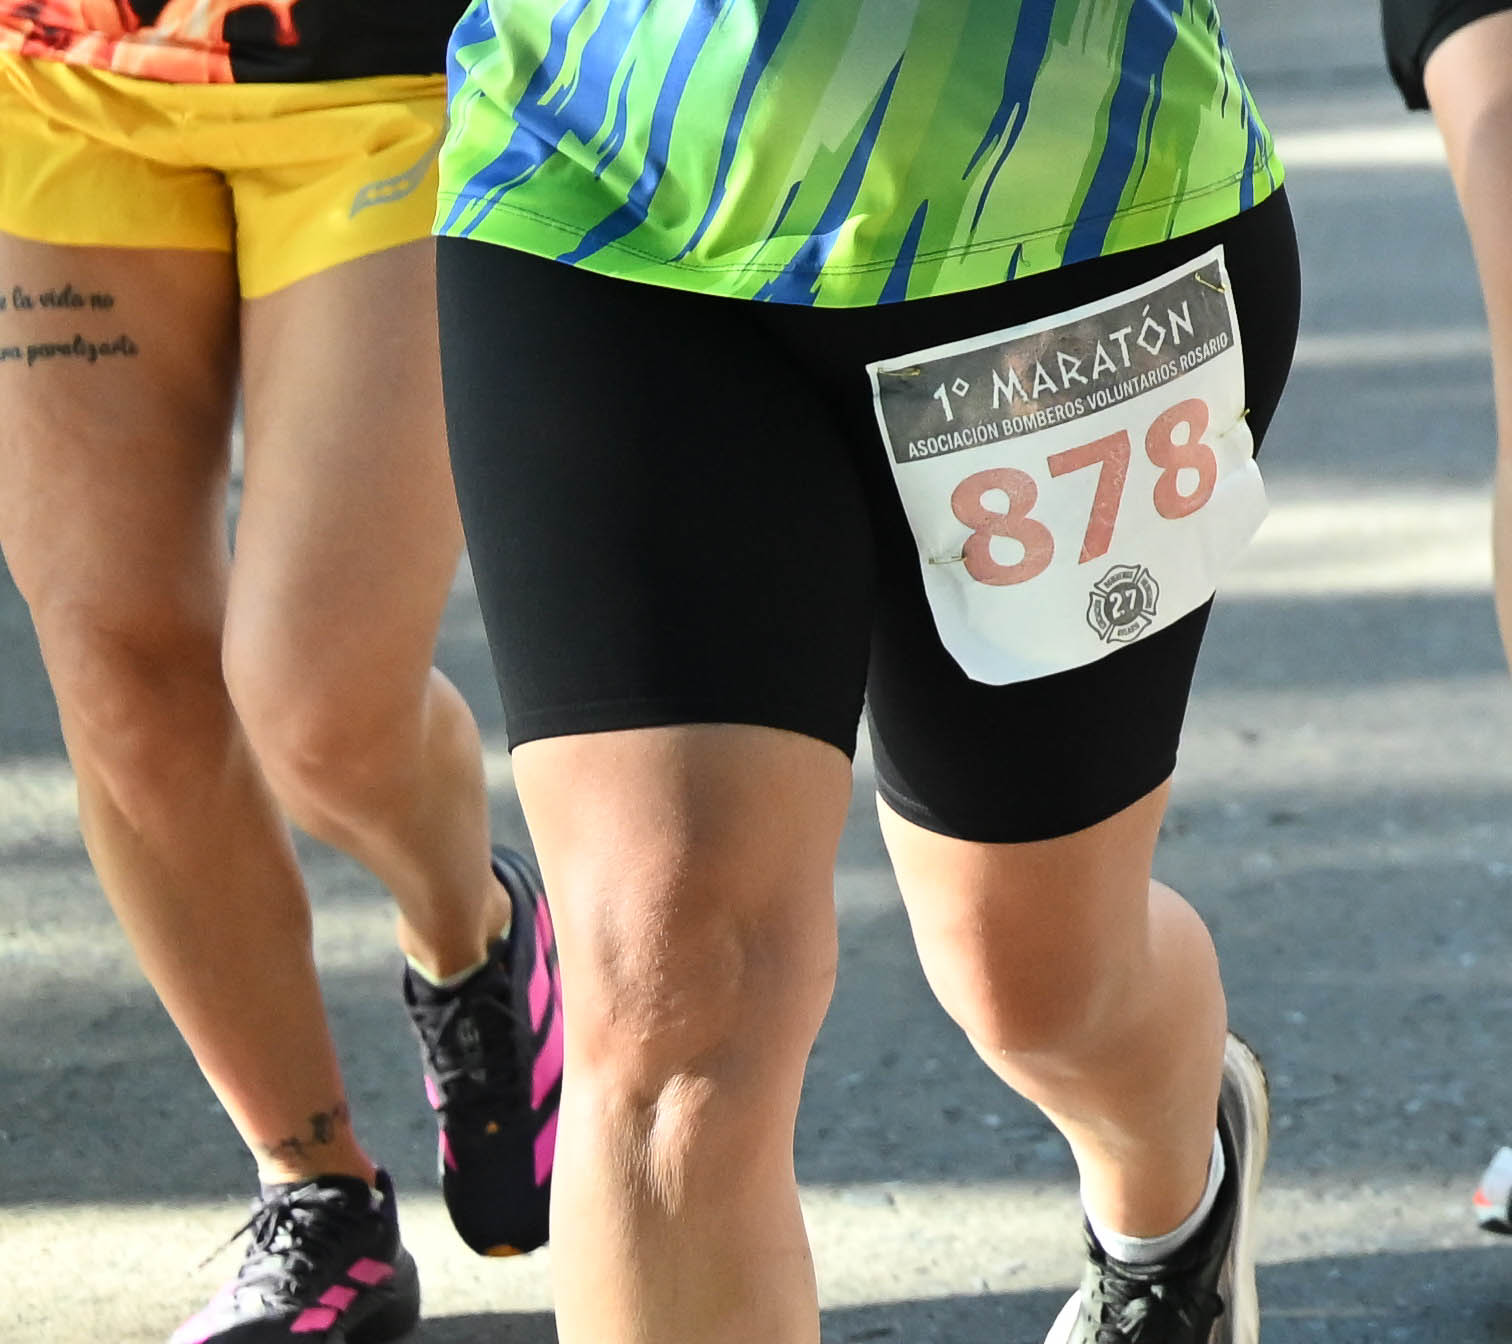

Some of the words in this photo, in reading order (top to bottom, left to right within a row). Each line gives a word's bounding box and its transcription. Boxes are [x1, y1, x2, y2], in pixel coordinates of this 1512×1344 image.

[907, 418, 999, 459] ASOCIACIÓN
[1002, 398, 1084, 438] BOMBEROS
[1086, 361, 1178, 411] VOLUNTARIOS
[1179, 331, 1228, 372] ROSARIO
[991, 301, 1194, 410] MARATÓN
[950, 397, 1218, 587] 878
[1109, 588, 1138, 620] 27
